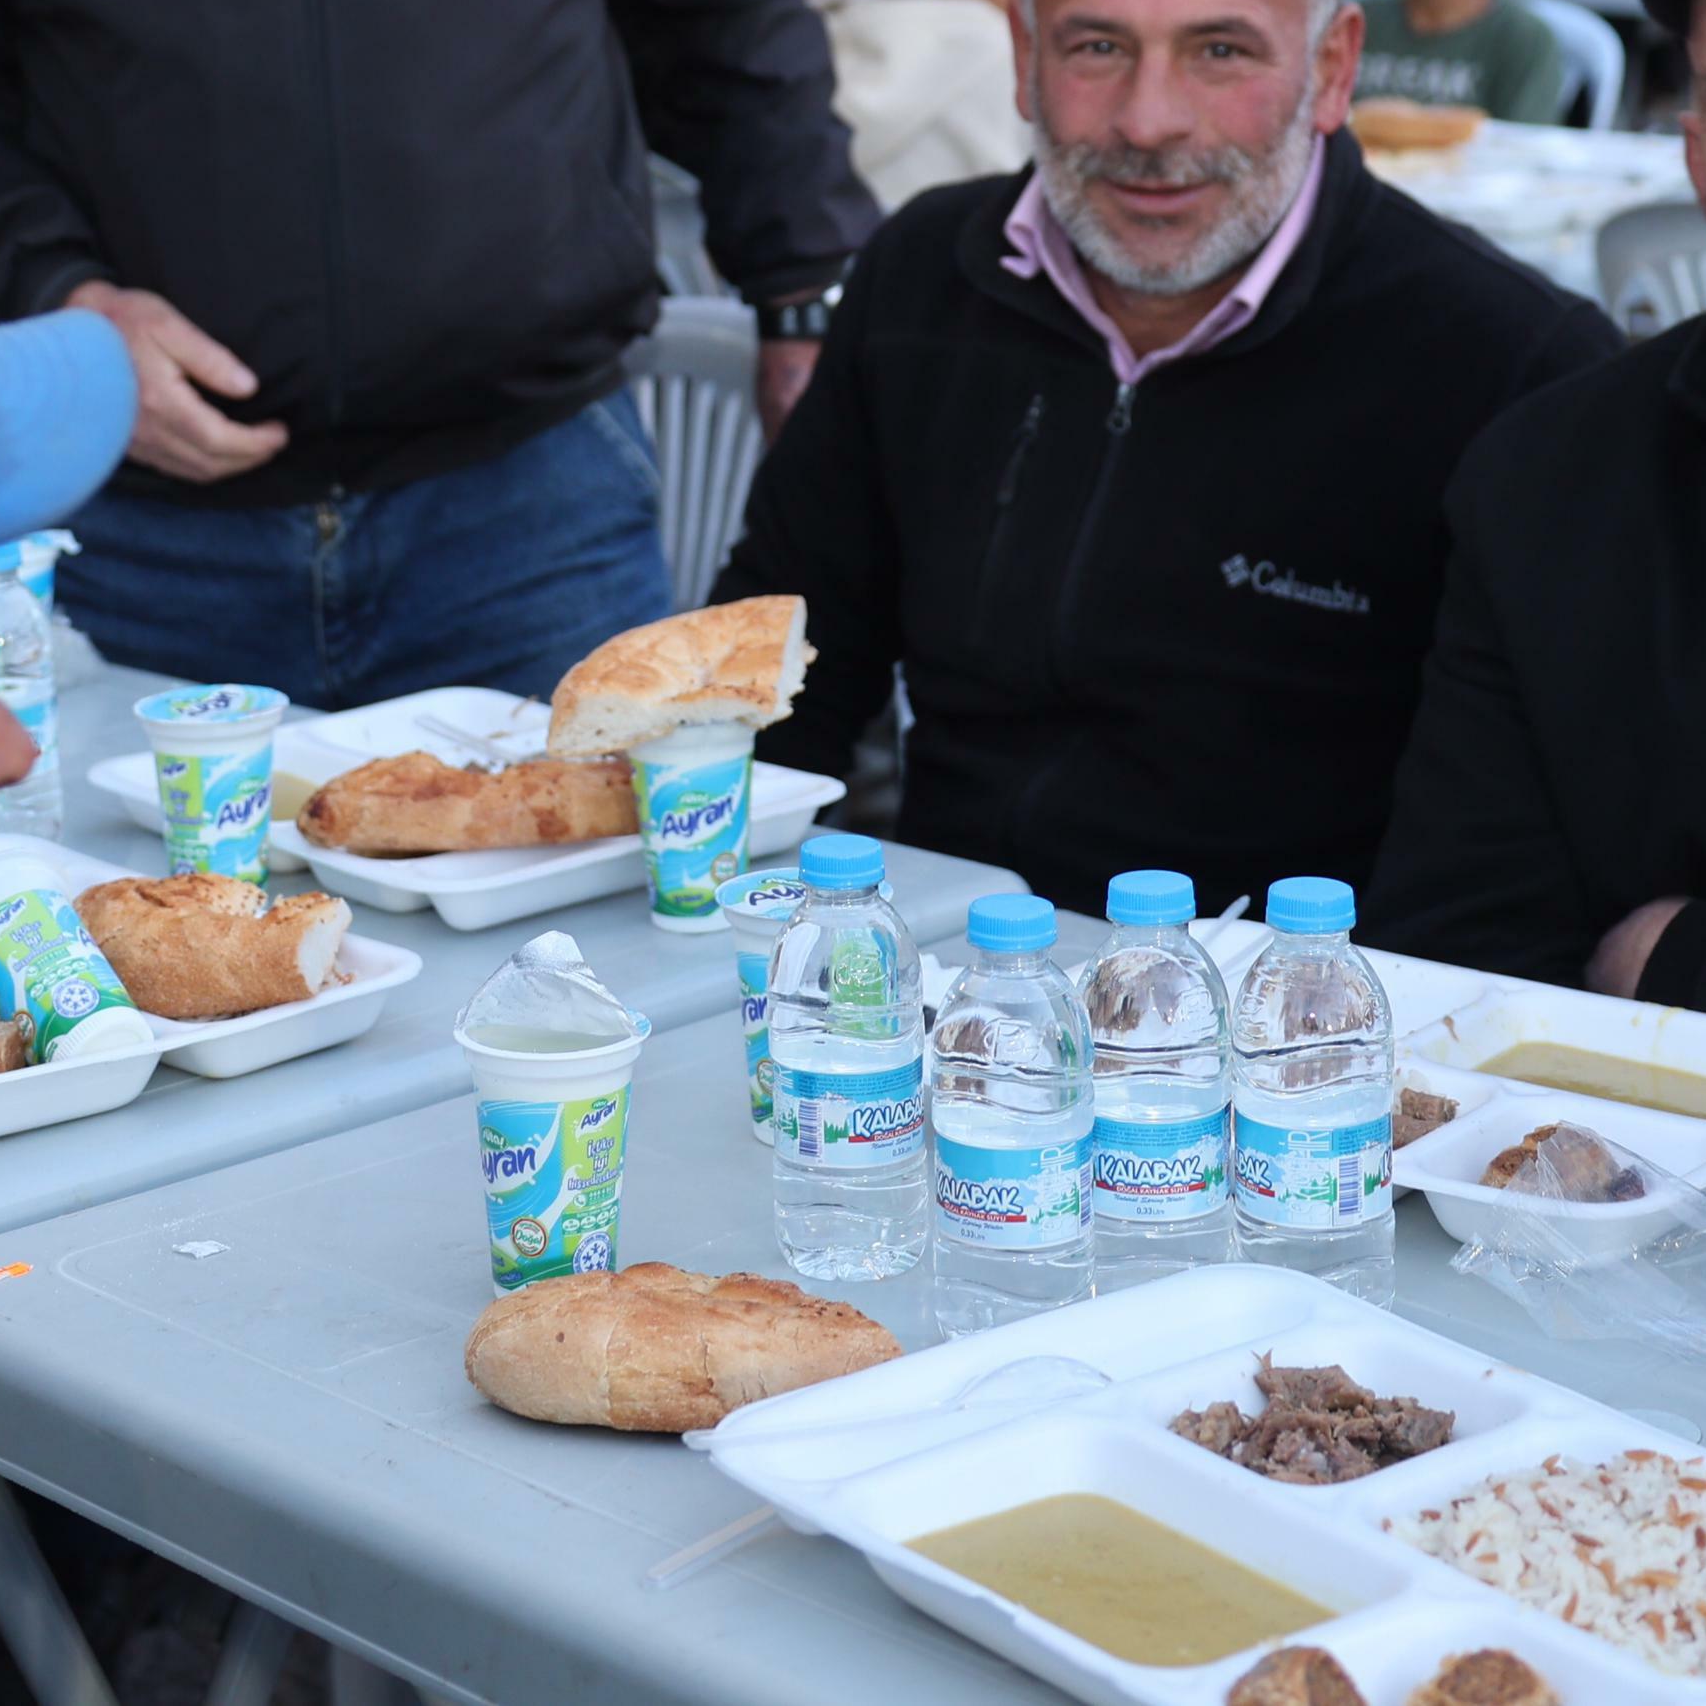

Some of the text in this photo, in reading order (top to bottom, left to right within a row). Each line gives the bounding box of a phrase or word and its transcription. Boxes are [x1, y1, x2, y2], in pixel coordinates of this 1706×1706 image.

[1251, 559, 1370, 613] Columbia
[217, 784, 272, 830] Ayra
[661, 795, 733, 839] Ayran
[580, 1100, 617, 1130] Ayran
[480, 1147, 536, 1184] yran
[1098, 1153, 1204, 1187] KALABAK
